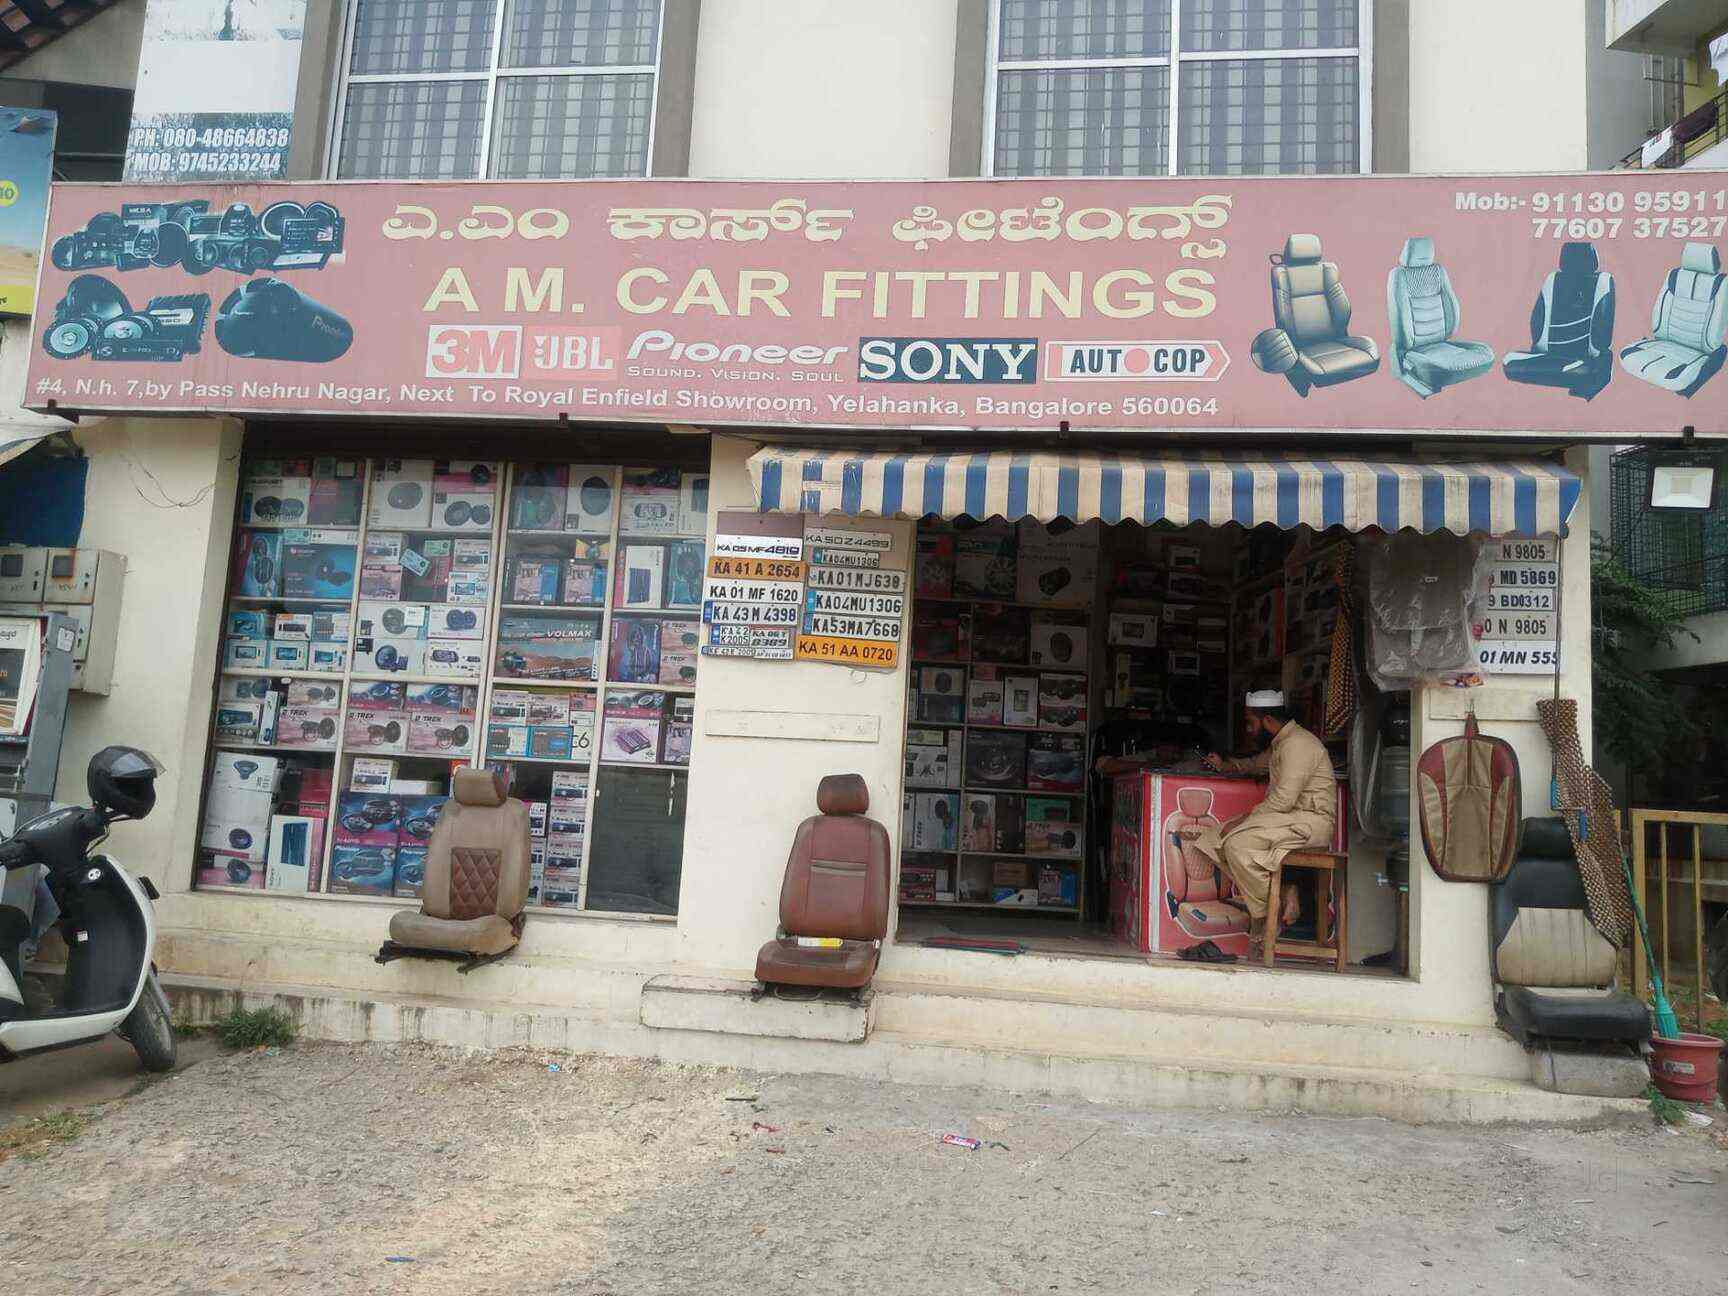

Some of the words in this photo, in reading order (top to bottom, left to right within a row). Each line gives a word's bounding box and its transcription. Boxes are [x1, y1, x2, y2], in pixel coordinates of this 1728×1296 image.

[1531, 191, 1624, 213] 91130
[1634, 190, 1728, 212] 95911
[1532, 217, 1624, 239] 77607
[1632, 216, 1728, 239] 37527
[422, 266, 480, 313] A
[503, 266, 585, 314] M.
[616, 267, 792, 318] CAR
[820, 268, 1218, 320] FITTINGS
[430, 328, 519, 375] 3M
[626, 329, 849, 366] Pioneer
[859, 340, 1036, 381] SONY
[179, 381, 234, 398] Pass
[241, 382, 309, 399] Nehru
[318, 383, 391, 405] Nagar,
[400, 385, 454, 402] Next
[469, 386, 497, 403] To
[505, 387, 573, 408] Royal
[582, 388, 668, 407] Enfield
[676, 389, 818, 414] Showroom,
[827, 394, 967, 418] Yelahanka,
[975, 395, 1113, 419] Bangalore
[1122, 397, 1219, 415] 560064
[714, 561, 731, 575] KA
[735, 562, 750, 576] 41
[755, 563, 763, 576] A
[709, 585, 727, 598] KA
[730, 586, 744, 599] 01
[748, 587, 766, 600] MF
[769, 588, 798, 602] 1620
[713, 606, 729, 621] KA
[733, 607, 749, 622] 43
[752, 607, 761, 622] M
[764, 607, 797, 622] 4398
[798, 641, 817, 654] KA
[840, 645, 858, 658] AA
[863, 646, 893, 661] 0720
[1499, 651, 1528, 665] MN
